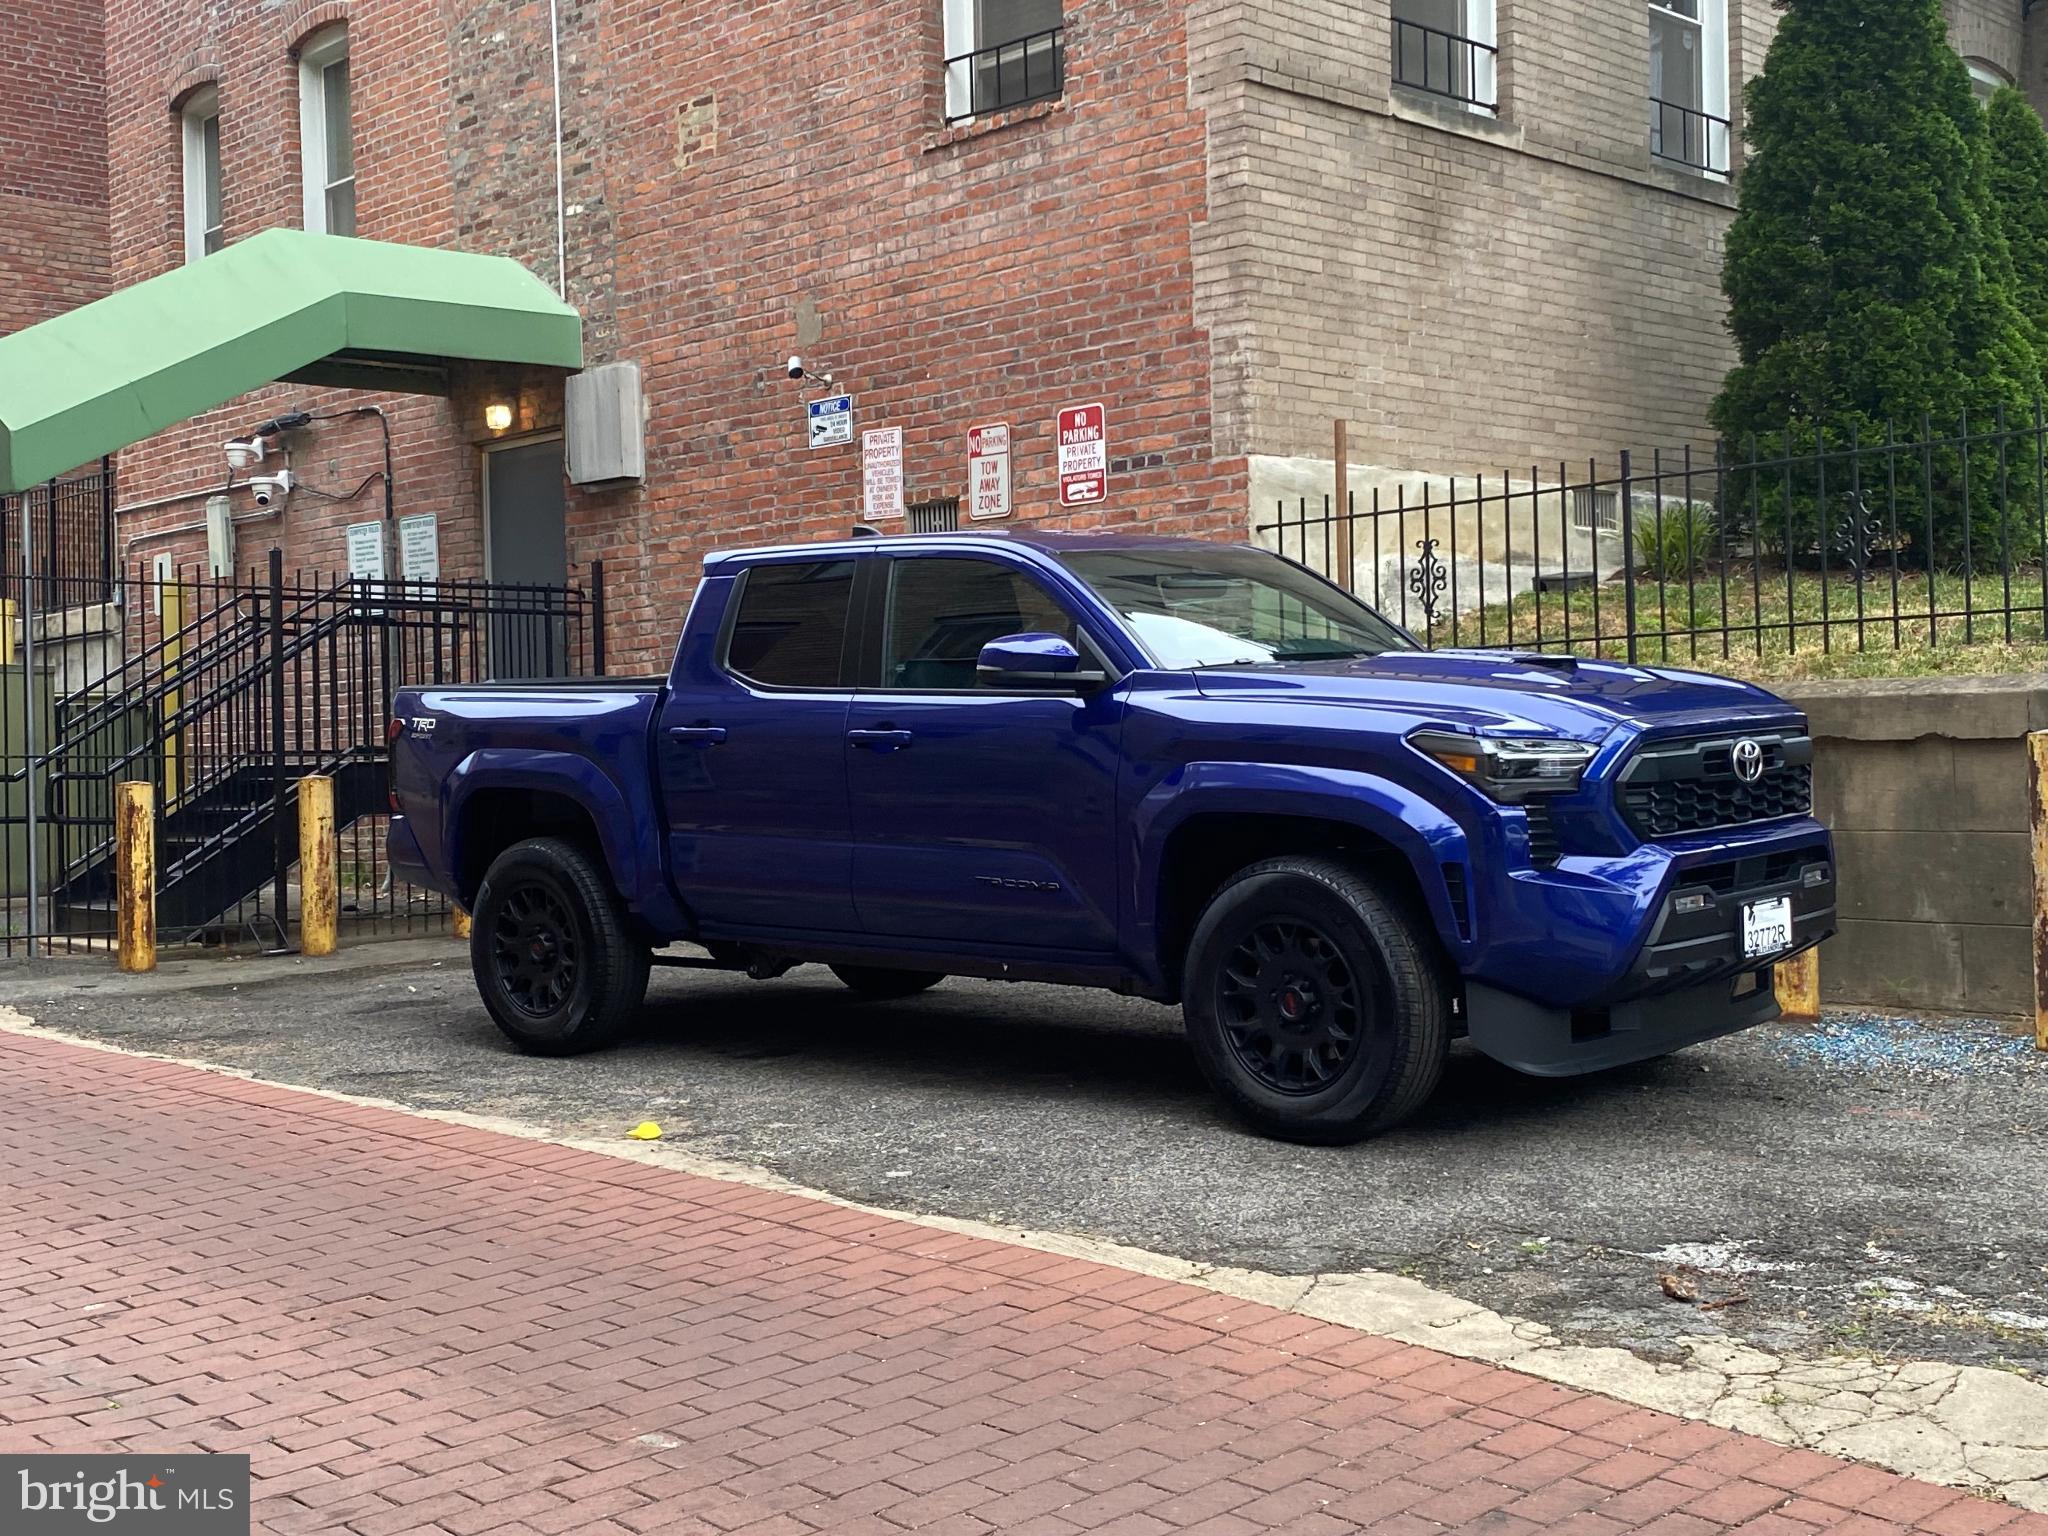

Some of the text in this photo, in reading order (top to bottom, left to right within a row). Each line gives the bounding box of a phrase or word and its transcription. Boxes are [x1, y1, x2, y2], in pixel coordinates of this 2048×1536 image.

[820, 400, 841, 414] NOTICE
[1074, 411, 1087, 428] NO
[869, 432, 895, 445] PRIVATE
[1062, 425, 1100, 445] PARKING
[969, 434, 1007, 454] NO PARKING
[1066, 443, 1097, 458] PRIVATE
[864, 446, 899, 459] PROPERTY
[981, 460, 998, 476] TOW
[1062, 456, 1102, 472] PROPERTY
[871, 467, 895, 477] VEHICLES
[979, 477, 1001, 493] AWAY
[884, 492, 895, 500] AND
[978, 494, 1002, 510] ZONE
[872, 501, 894, 510] EXPENSE
[411, 717, 436, 732] TRD
[1748, 924, 1786, 949] 32772R
